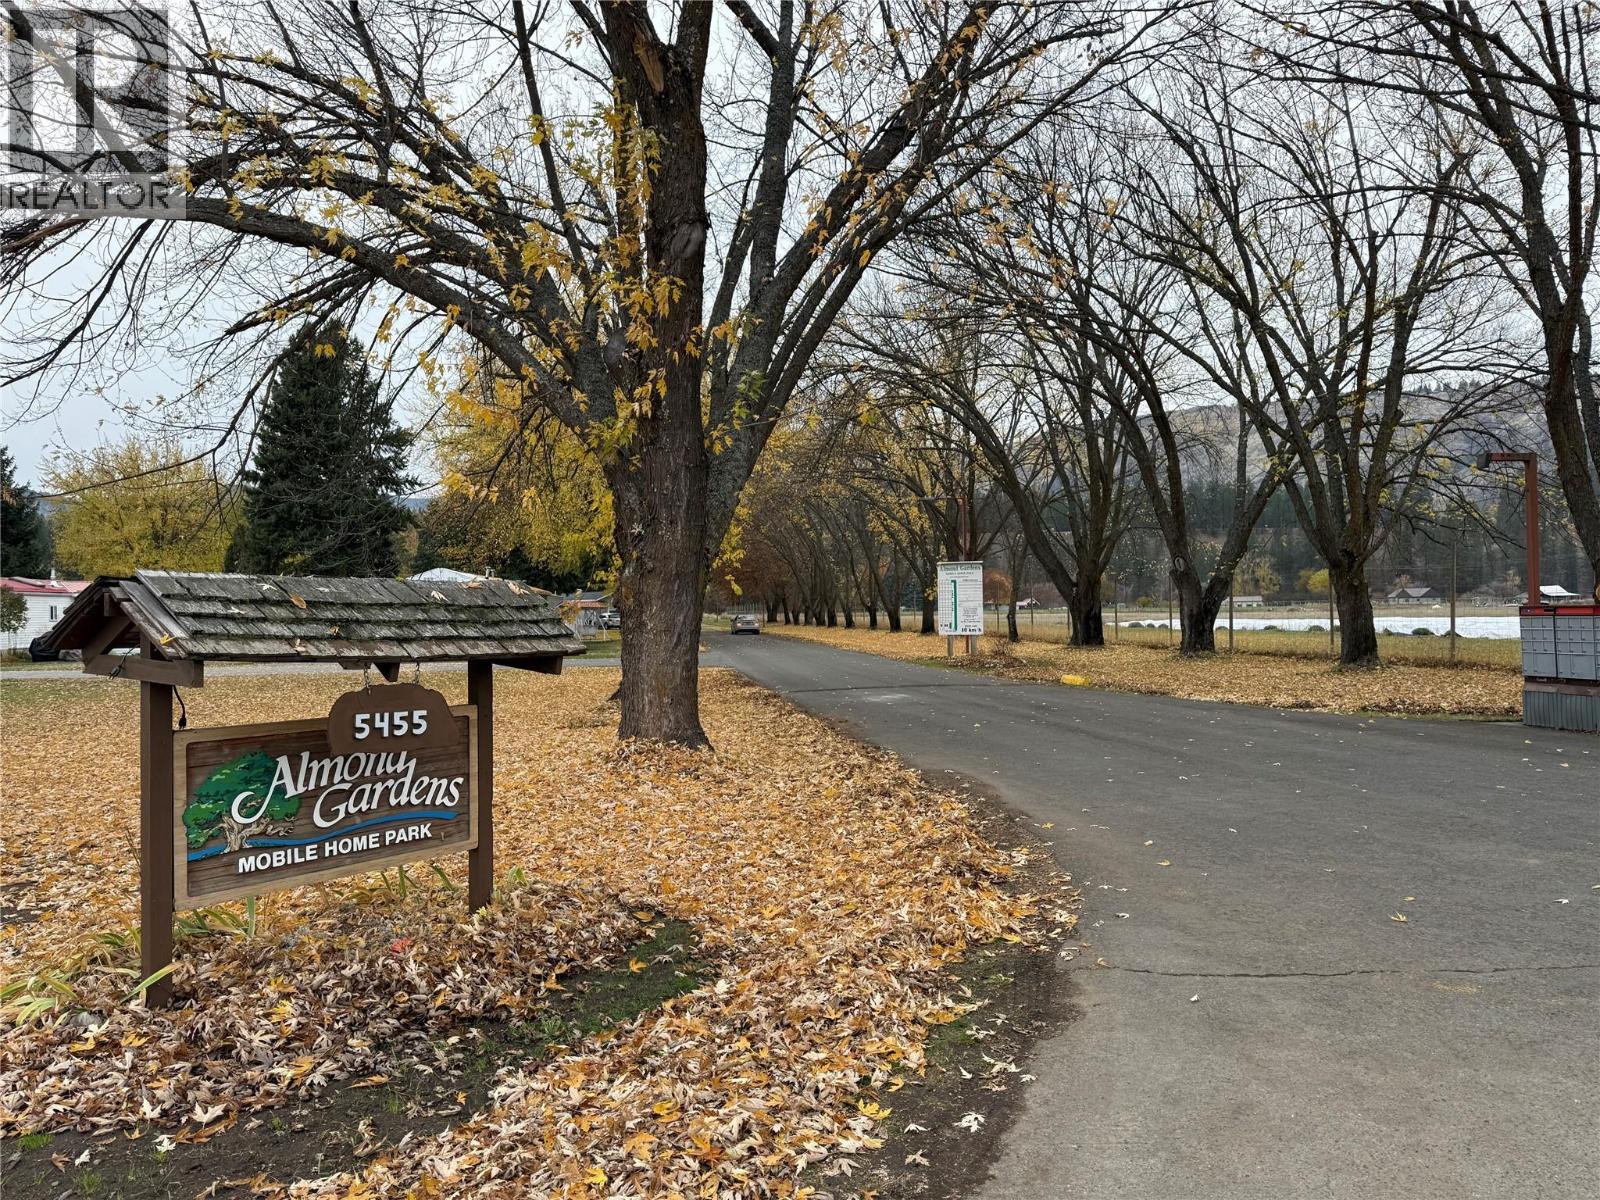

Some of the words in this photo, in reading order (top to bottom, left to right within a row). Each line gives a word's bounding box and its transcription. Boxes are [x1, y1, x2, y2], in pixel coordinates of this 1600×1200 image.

[354, 709, 429, 740] 5455
[312, 757, 465, 829] Gardens
[238, 844, 318, 873] MOBILE
[324, 832, 380, 858] HOME
[385, 822, 433, 846] PARK
